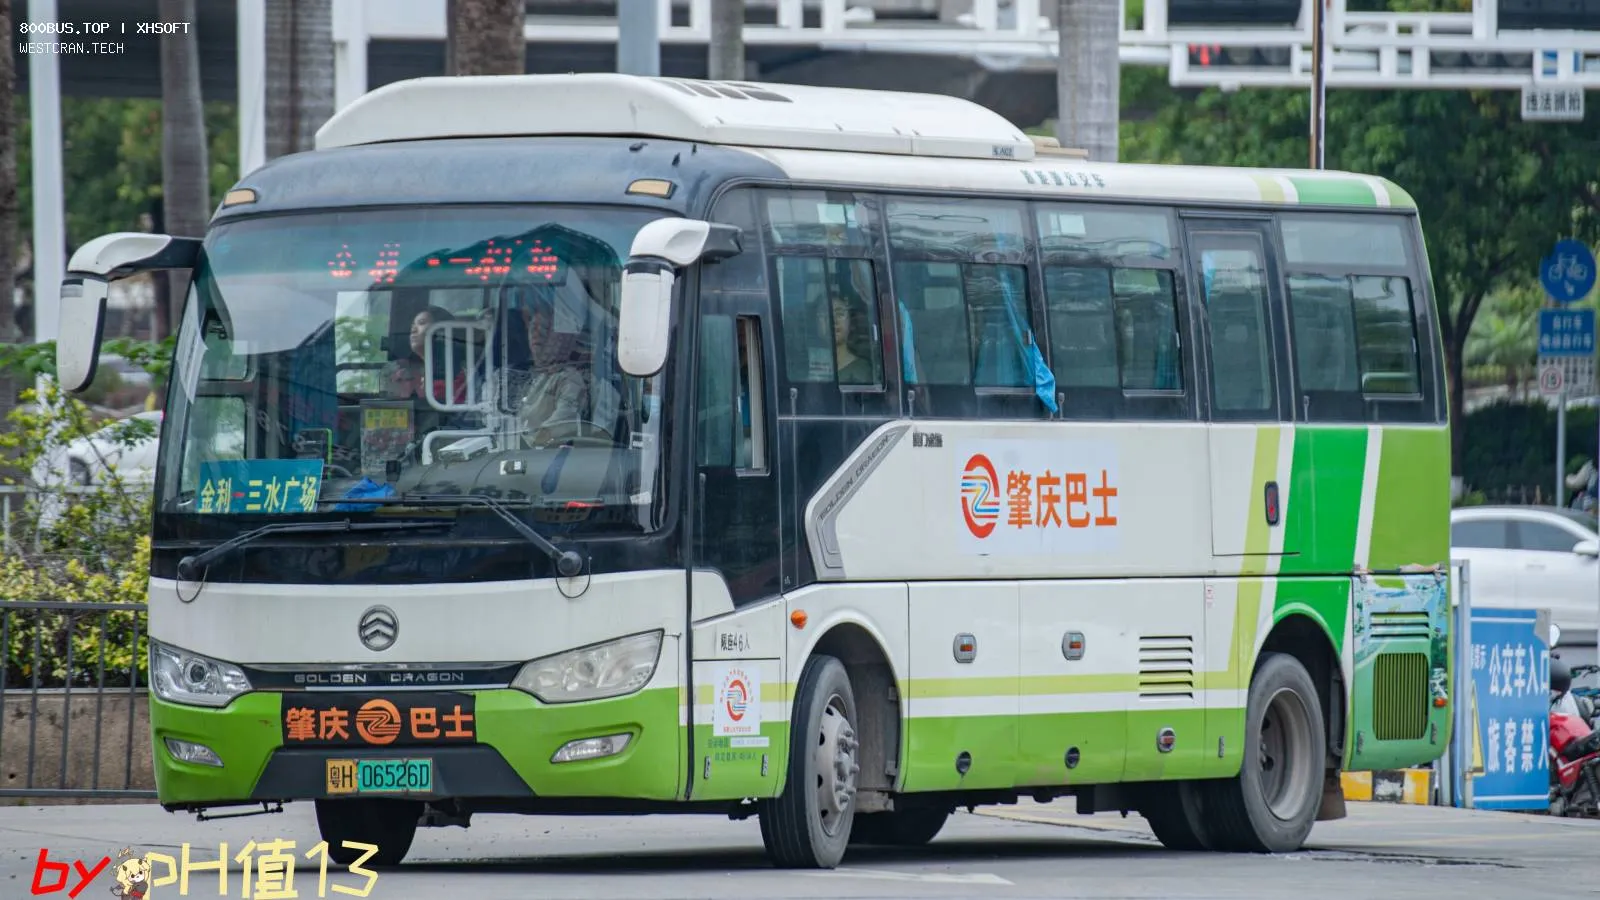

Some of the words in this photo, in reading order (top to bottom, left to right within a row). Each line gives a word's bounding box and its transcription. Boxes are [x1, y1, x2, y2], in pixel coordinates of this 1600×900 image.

[1006, 469, 1118, 529] 肇庆巴士
[294, 673, 367, 683] GOLDEN
[390, 672, 464, 682] DRAGON
[1489, 643, 1549, 699] 公交车入口
[286, 706, 349, 741] 肇庆
[410, 704, 474, 739] 巴士
[1488, 717, 1549, 774] 旅客禁入
